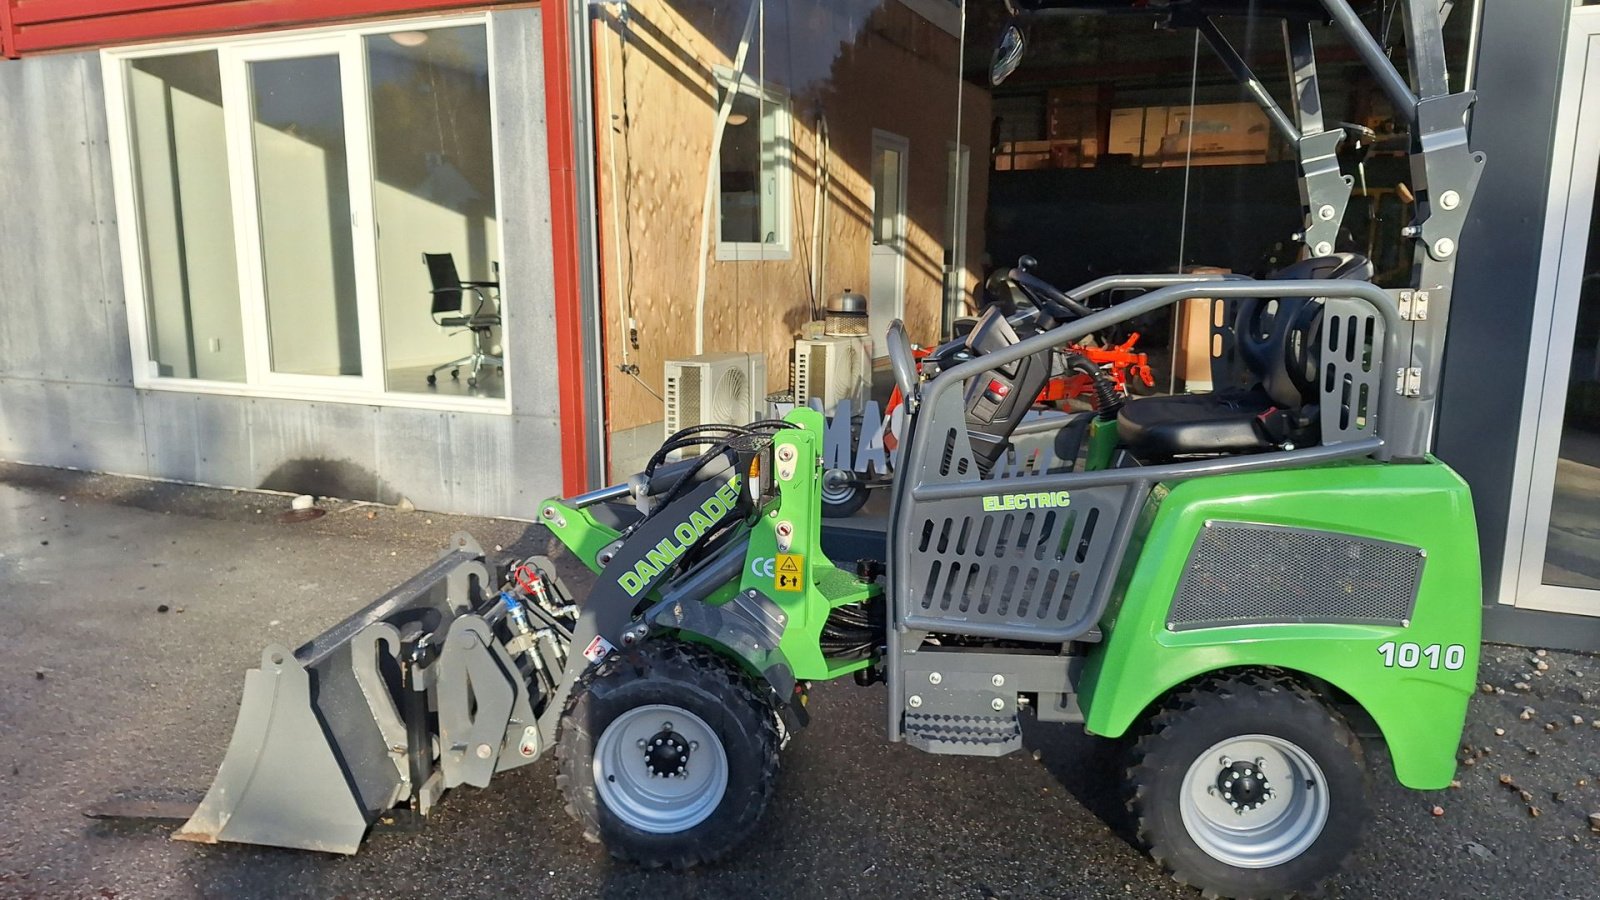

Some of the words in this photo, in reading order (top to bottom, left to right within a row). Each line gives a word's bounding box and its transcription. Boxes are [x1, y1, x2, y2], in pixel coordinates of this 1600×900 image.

[982, 491, 1071, 512] ELECTRIC
[751, 557, 776, 578] CE
[1376, 641, 1466, 671] 1010
